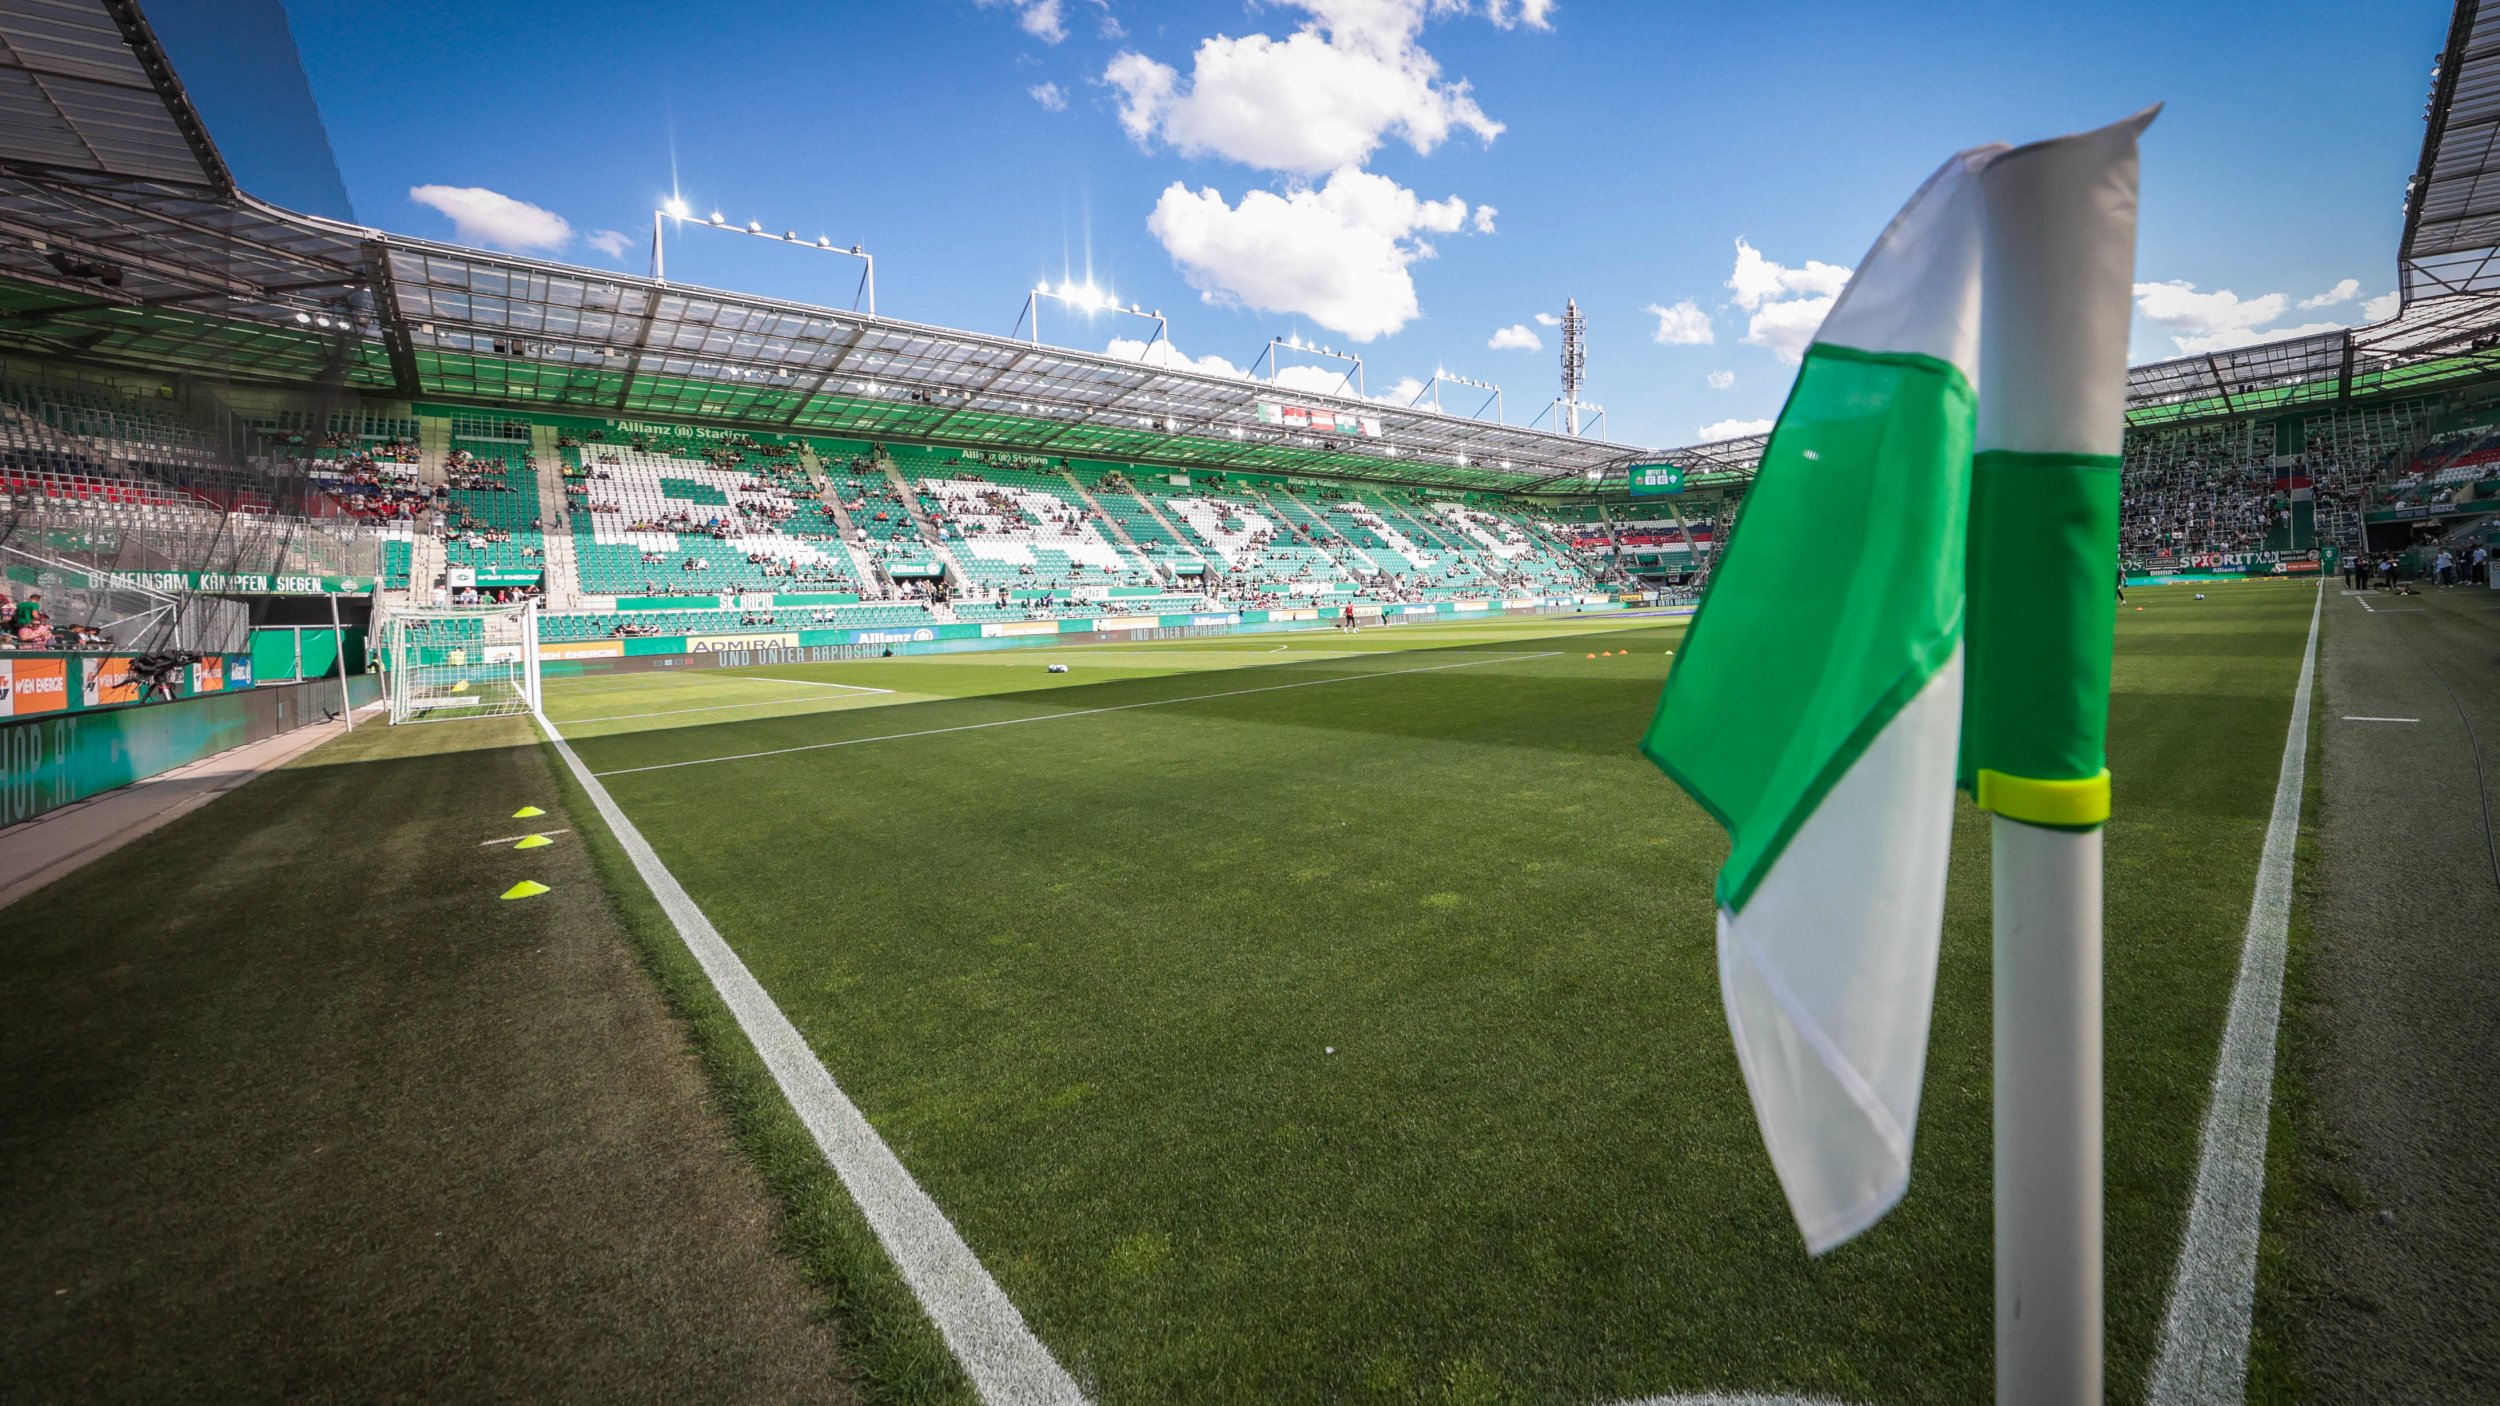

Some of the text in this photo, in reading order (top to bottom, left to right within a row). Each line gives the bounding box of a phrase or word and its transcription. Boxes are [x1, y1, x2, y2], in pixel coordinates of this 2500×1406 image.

[616, 421, 671, 435] Allianz
[1012, 454, 1049, 465] Stadion
[889, 564, 926, 573] Allianz
[88, 571, 324, 593] GEMEINSAM. KÄMPFEN. SIEGEN.
[719, 594, 774, 609] SK RAPID
[858, 632, 912, 644] Allianz
[1131, 628, 1149, 641] UND
[1153, 626, 1180, 640] UNTER
[692, 637, 788, 653] ADMIRAL
[718, 651, 751, 667] UND
[758, 647, 805, 664] UNTER
[15, 677, 64, 694] WIEN ENERGIE
